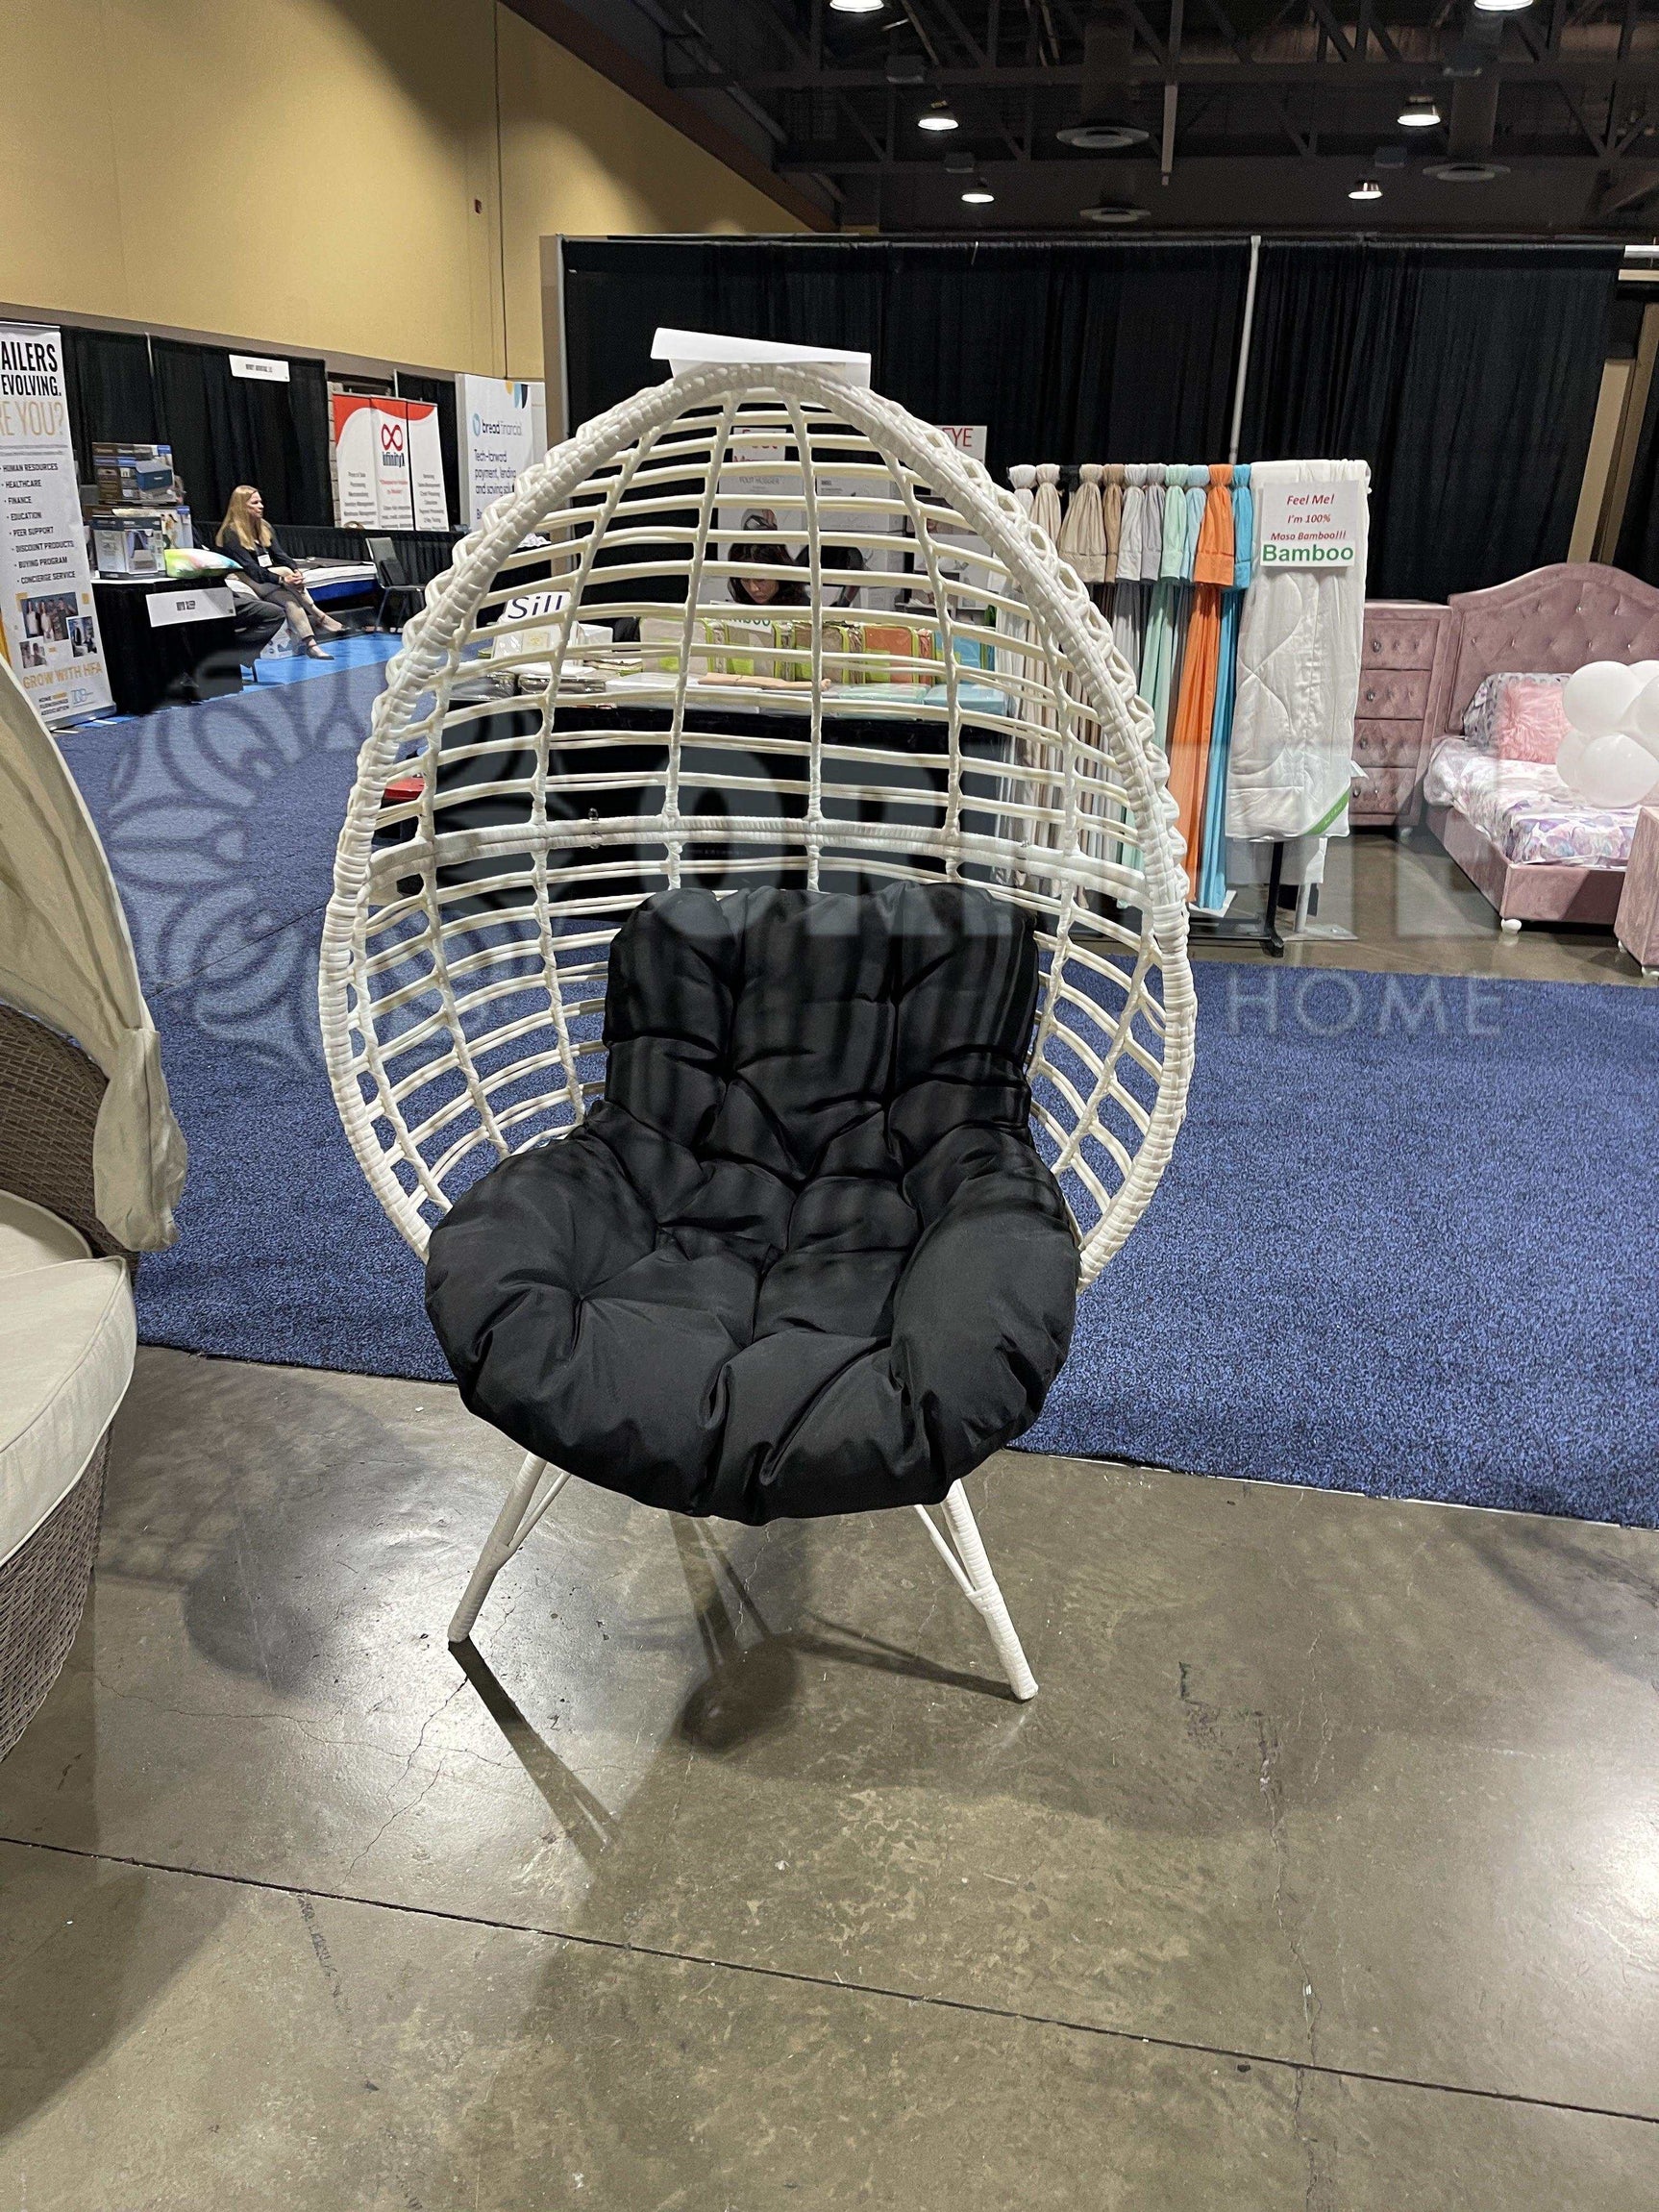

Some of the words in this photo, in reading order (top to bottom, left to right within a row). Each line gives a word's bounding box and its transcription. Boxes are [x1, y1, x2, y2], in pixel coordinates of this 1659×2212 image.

[1, 341, 58, 372] AILERS
[1, 374, 62, 397] EVOLVING.
[14, 401, 64, 436] YOU?
[482, 419, 500, 435] bread
[474, 448, 508, 463] Tech-forward
[6, 480, 42, 488] HEALTHCARE
[475, 484, 486, 494] and
[8, 496, 33, 505] FINANCE
[1286, 494, 1310, 506] Feel
[1312, 493, 1335, 506] Me!
[11, 512, 42, 521] EDUCATION
[1287, 515, 1303, 524] I'm
[1305, 514, 1331, 524] 100%
[28, 527, 54, 535] SUPPORT
[1298, 531, 1347, 540] Bamboo!!!
[44, 540, 74, 550] PRODUCTS
[1262, 543, 1354, 562] Bamboo
[39, 557, 68, 565] PROGRAM
[52, 571, 76, 580] SERVICE
[22, 670, 54, 689] GROW
[55, 665, 82, 682] WITH
[83, 661, 104, 677] HFA
